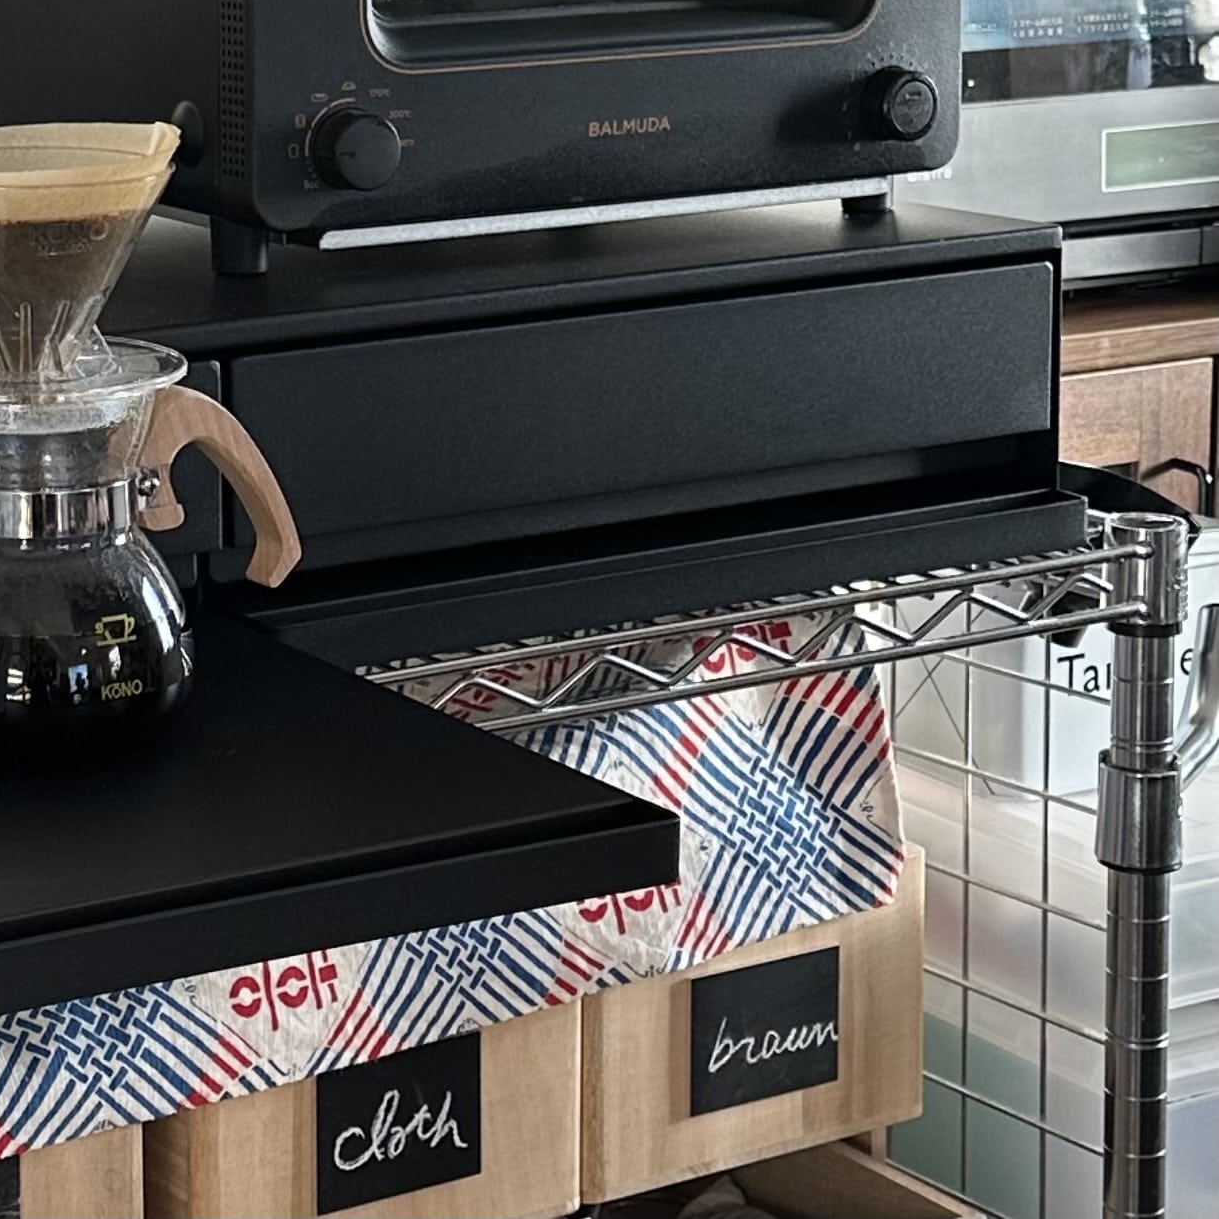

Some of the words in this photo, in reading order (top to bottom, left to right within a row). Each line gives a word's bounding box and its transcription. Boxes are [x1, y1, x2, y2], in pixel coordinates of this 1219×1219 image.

[588, 116, 671, 137] BALMUDA
[707, 1016, 840, 1073] braun
[333, 1088, 469, 1171] cloth
